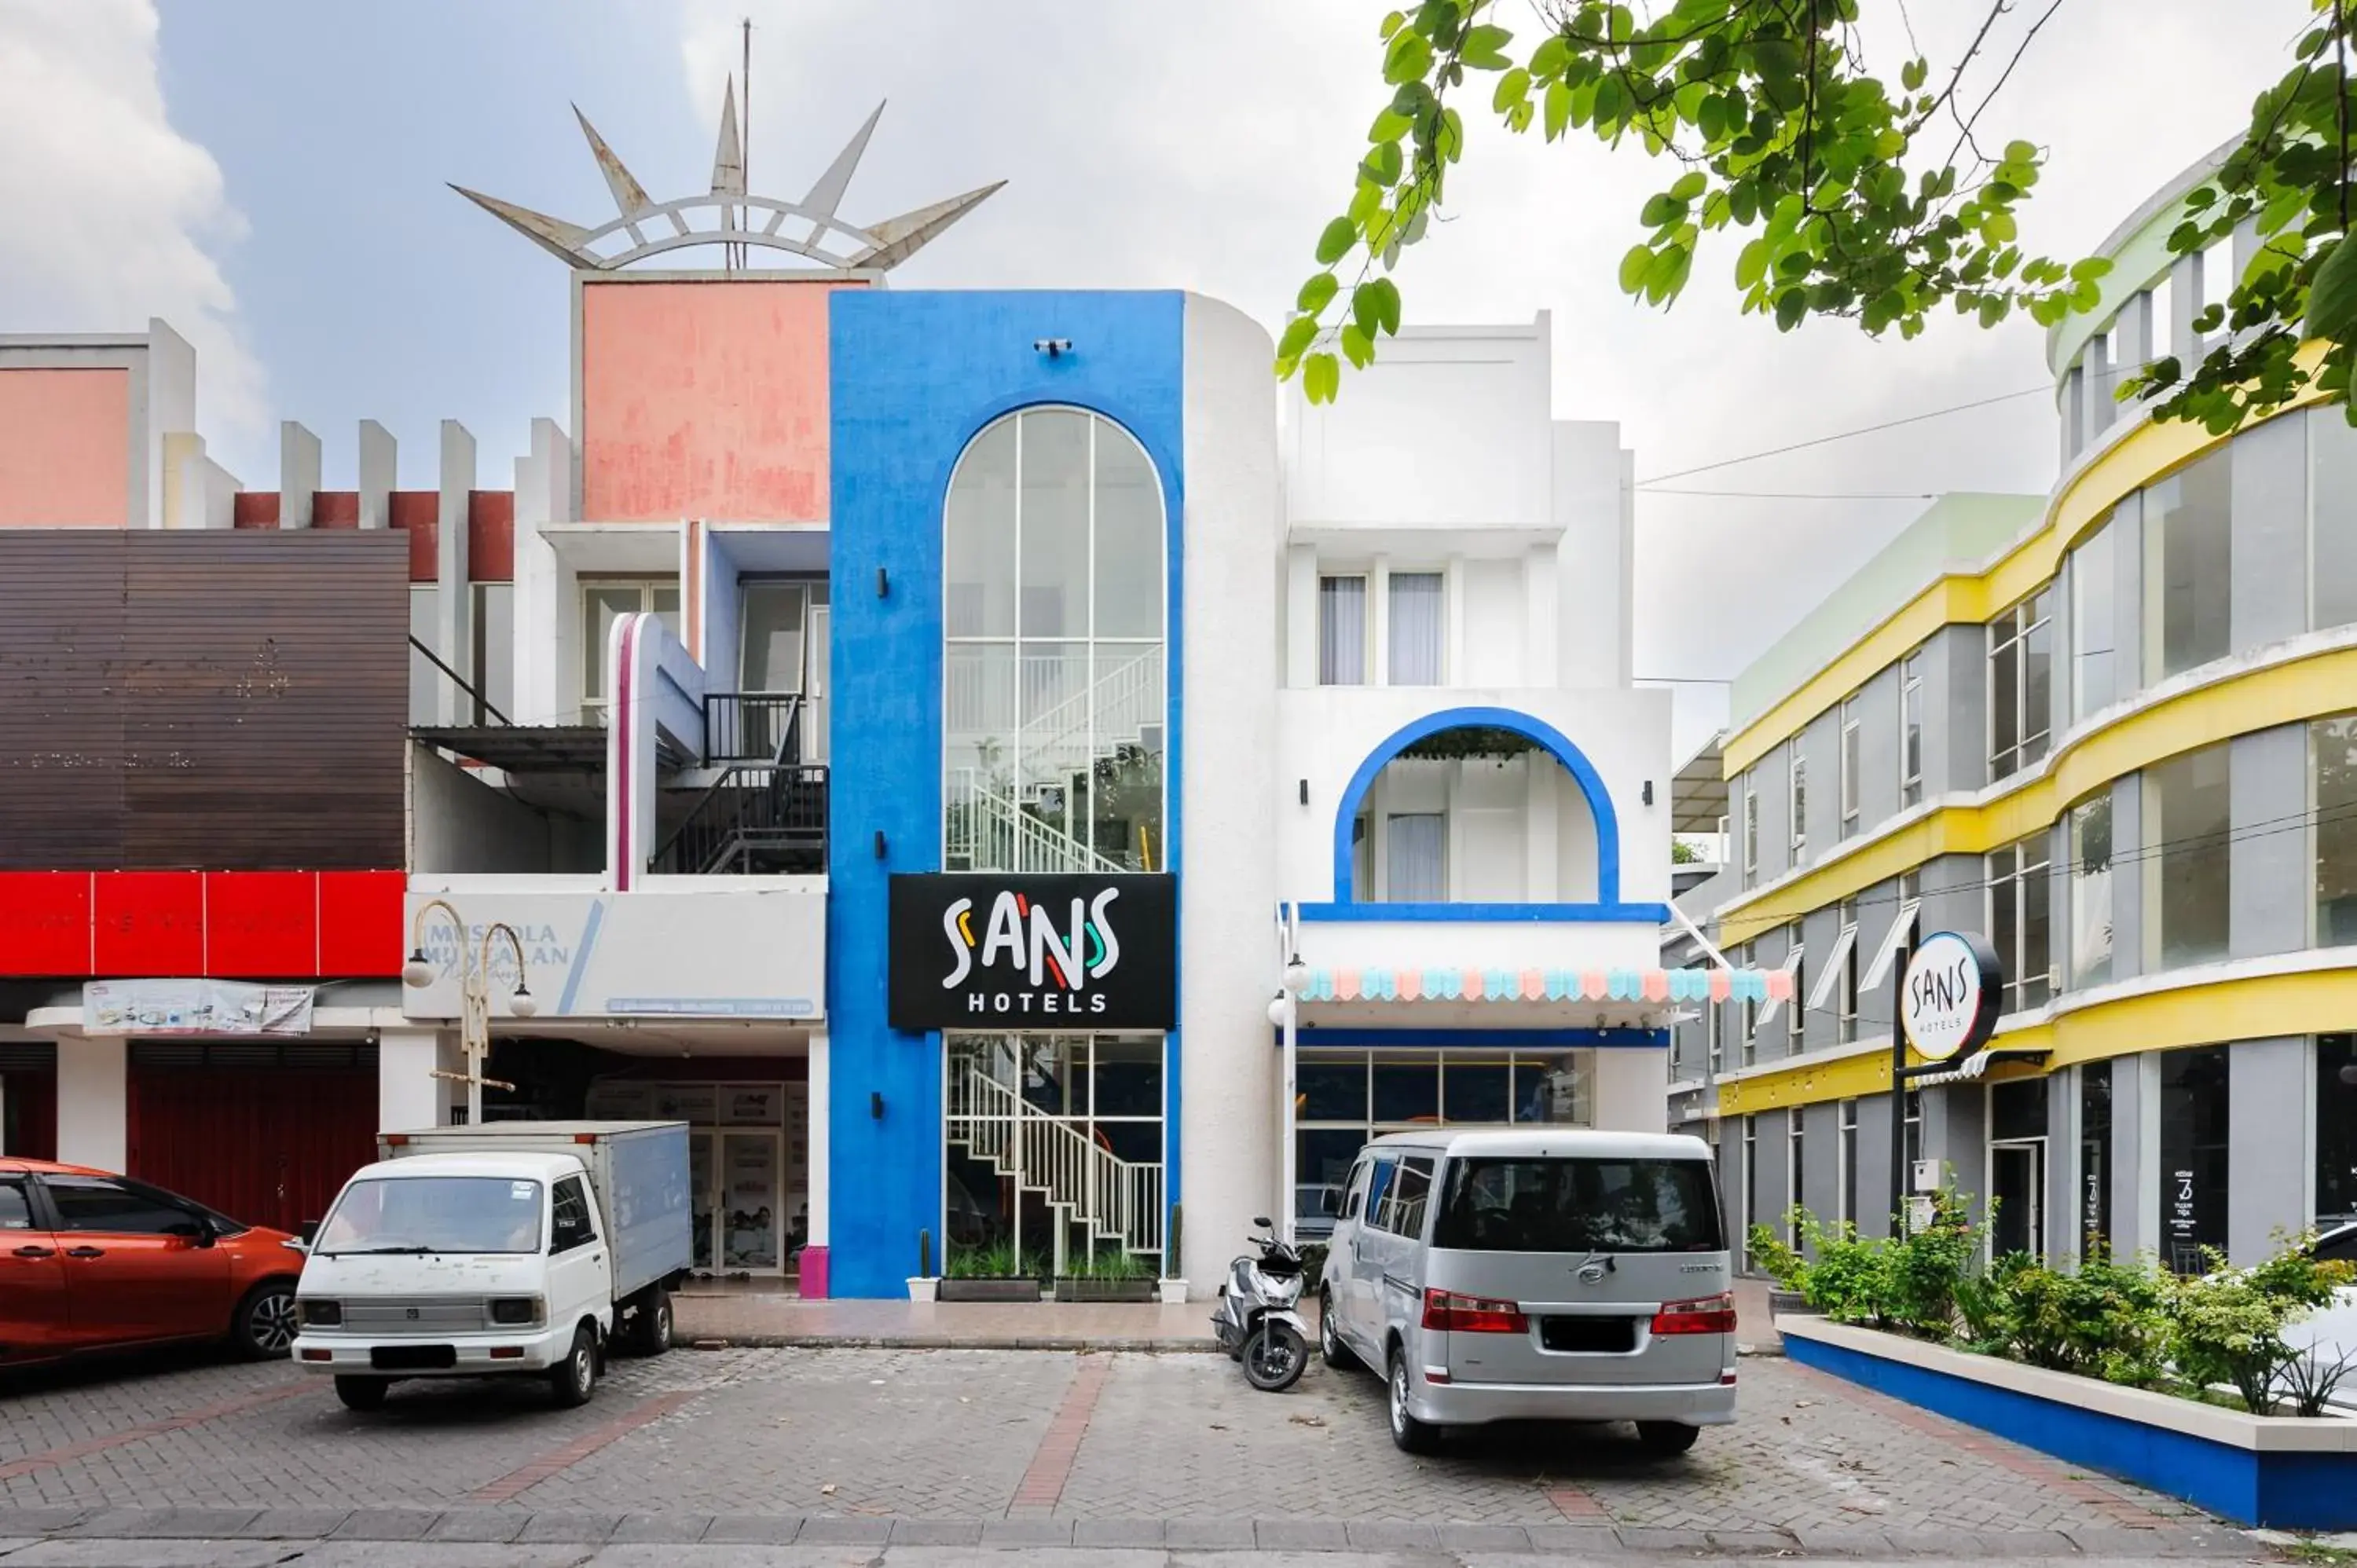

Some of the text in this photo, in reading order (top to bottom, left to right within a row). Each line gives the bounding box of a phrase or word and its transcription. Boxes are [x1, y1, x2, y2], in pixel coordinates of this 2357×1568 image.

[942, 887, 1120, 991] SANS
[421, 947, 569, 965] MUNAAN
[1912, 957, 1967, 1018] SANS
[968, 993, 1107, 1013] HOTELS
[1919, 1017, 1962, 1033] HOTELS
